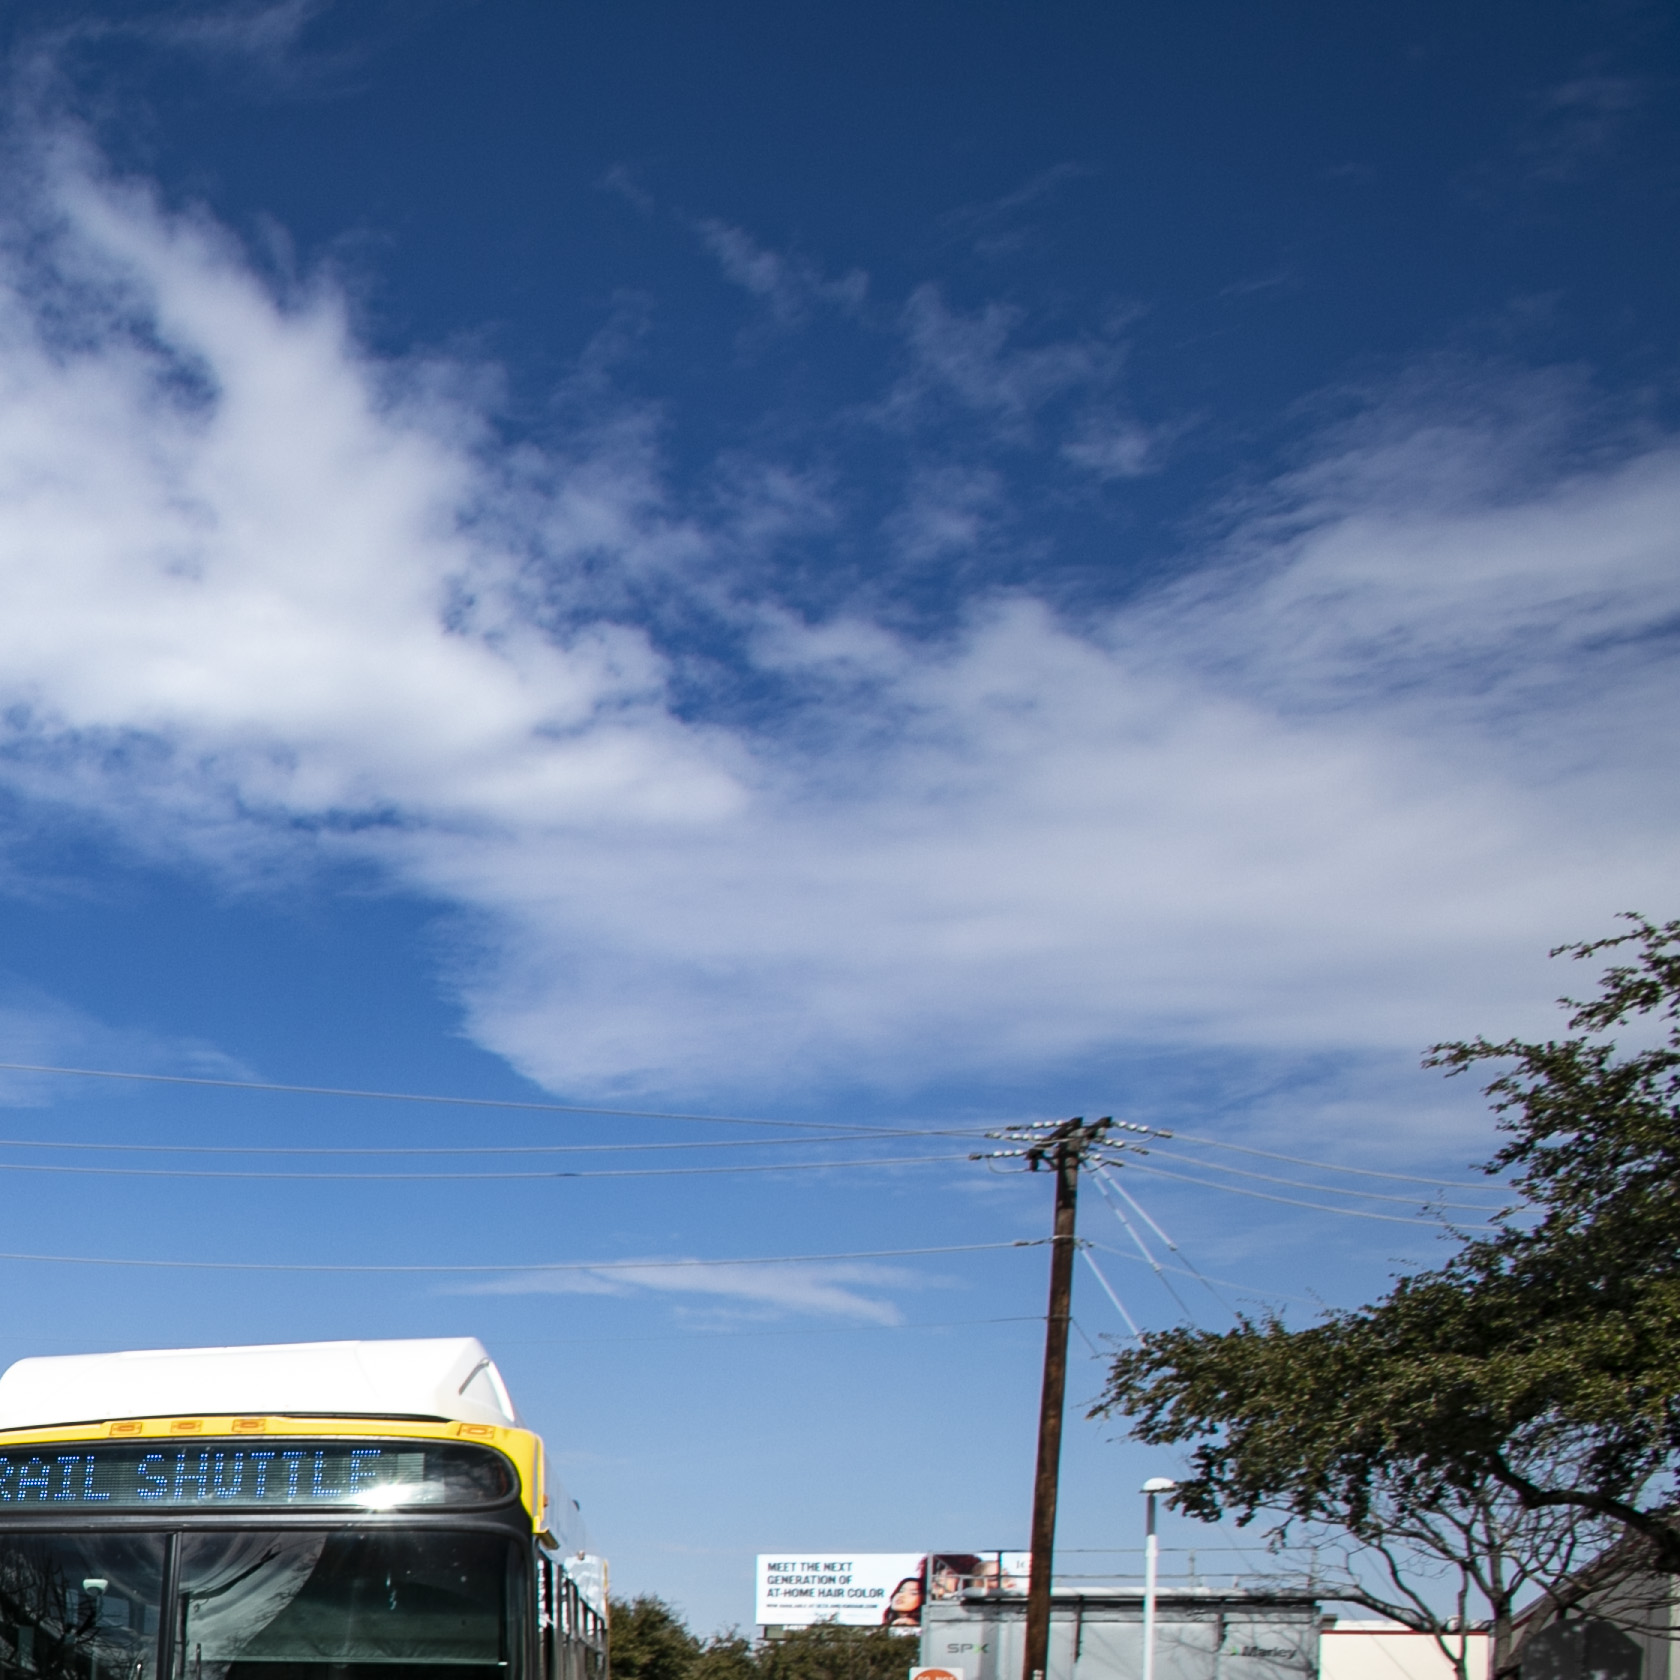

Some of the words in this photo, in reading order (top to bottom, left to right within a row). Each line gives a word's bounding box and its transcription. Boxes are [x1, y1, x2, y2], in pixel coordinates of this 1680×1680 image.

[137, 1448, 382, 1501] SHUTTLE
[767, 1562, 796, 1572] MEET
[800, 1562, 821, 1572] THE
[823, 1562, 853, 1572] NEXT
[767, 1575, 836, 1585] GENERATION
[839, 1575, 853, 1585] OF
[767, 1588, 816, 1598] AT-HOME
[818, 1588, 845, 1598] HAIR
[847, 1588, 885, 1598] COLOR
[947, 1643, 990, 1654] SPX
[1241, 1646, 1297, 1660] Marley
